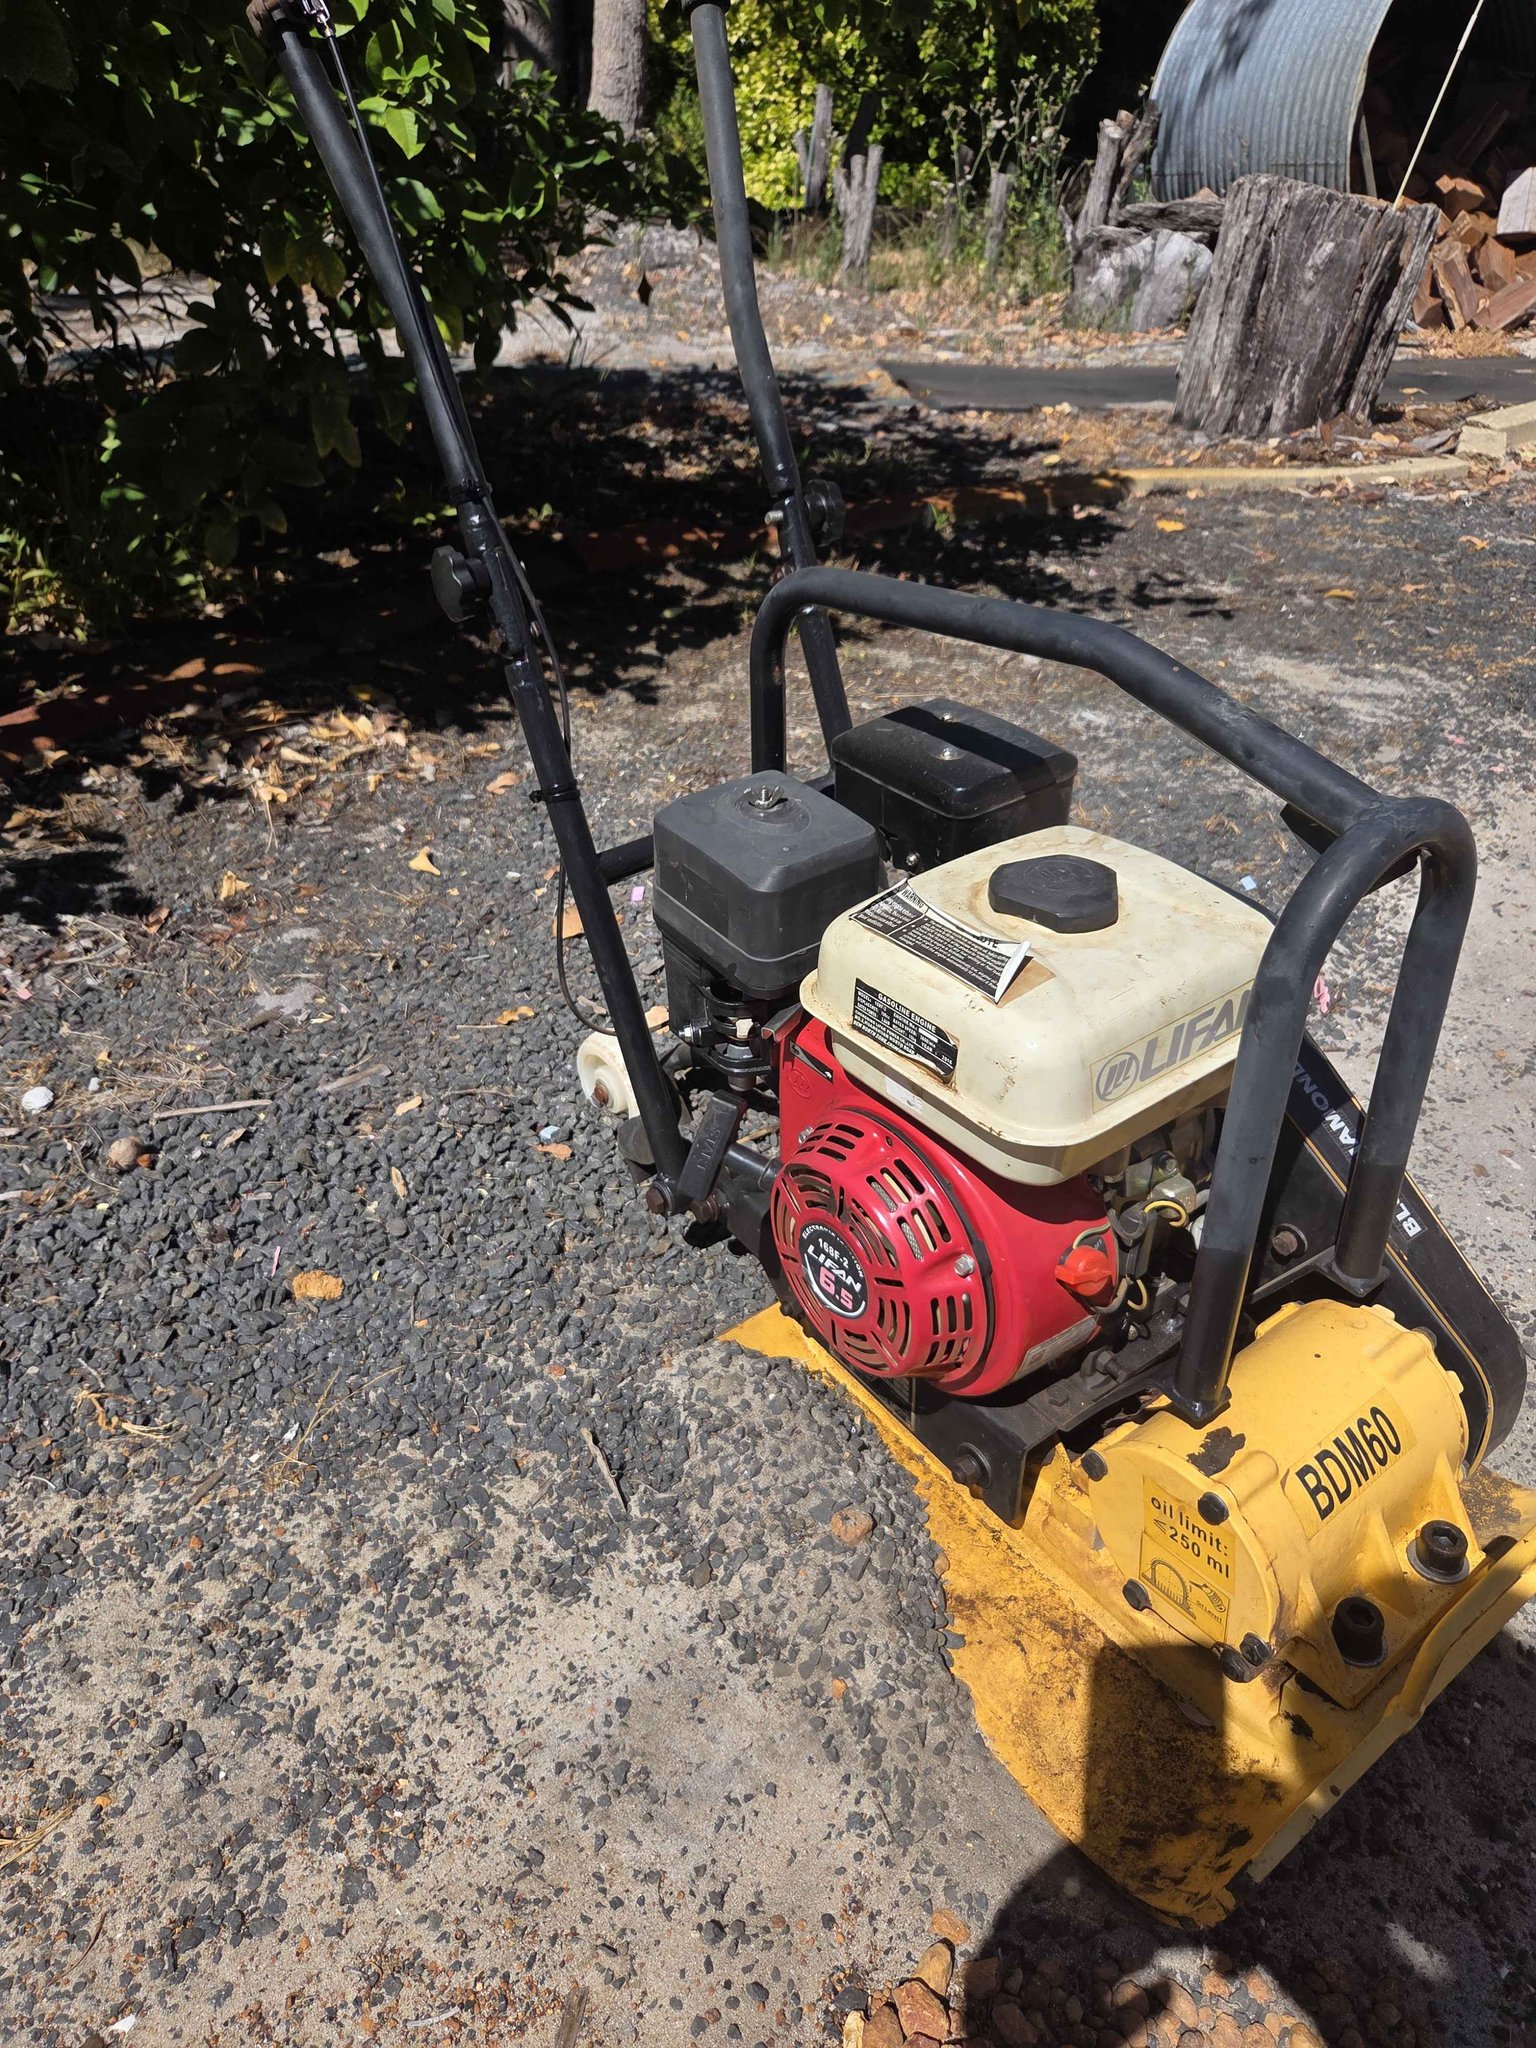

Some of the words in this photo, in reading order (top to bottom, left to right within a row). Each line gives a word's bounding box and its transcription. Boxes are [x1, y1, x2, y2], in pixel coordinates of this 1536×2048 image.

[878, 993, 911, 1018] GASOLINE
[911, 1014, 937, 1034] ENGINE
[807, 1244, 862, 1293] LIFAN
[818, 1238, 849, 1269] 168F-2
[820, 1266, 853, 1310] 6.5
[1295, 1406, 1401, 1521] BDM60
[1151, 1497, 1174, 1520] oil
[1179, 1511, 1229, 1557] limit:
[1207, 1554, 1230, 1579] ml
